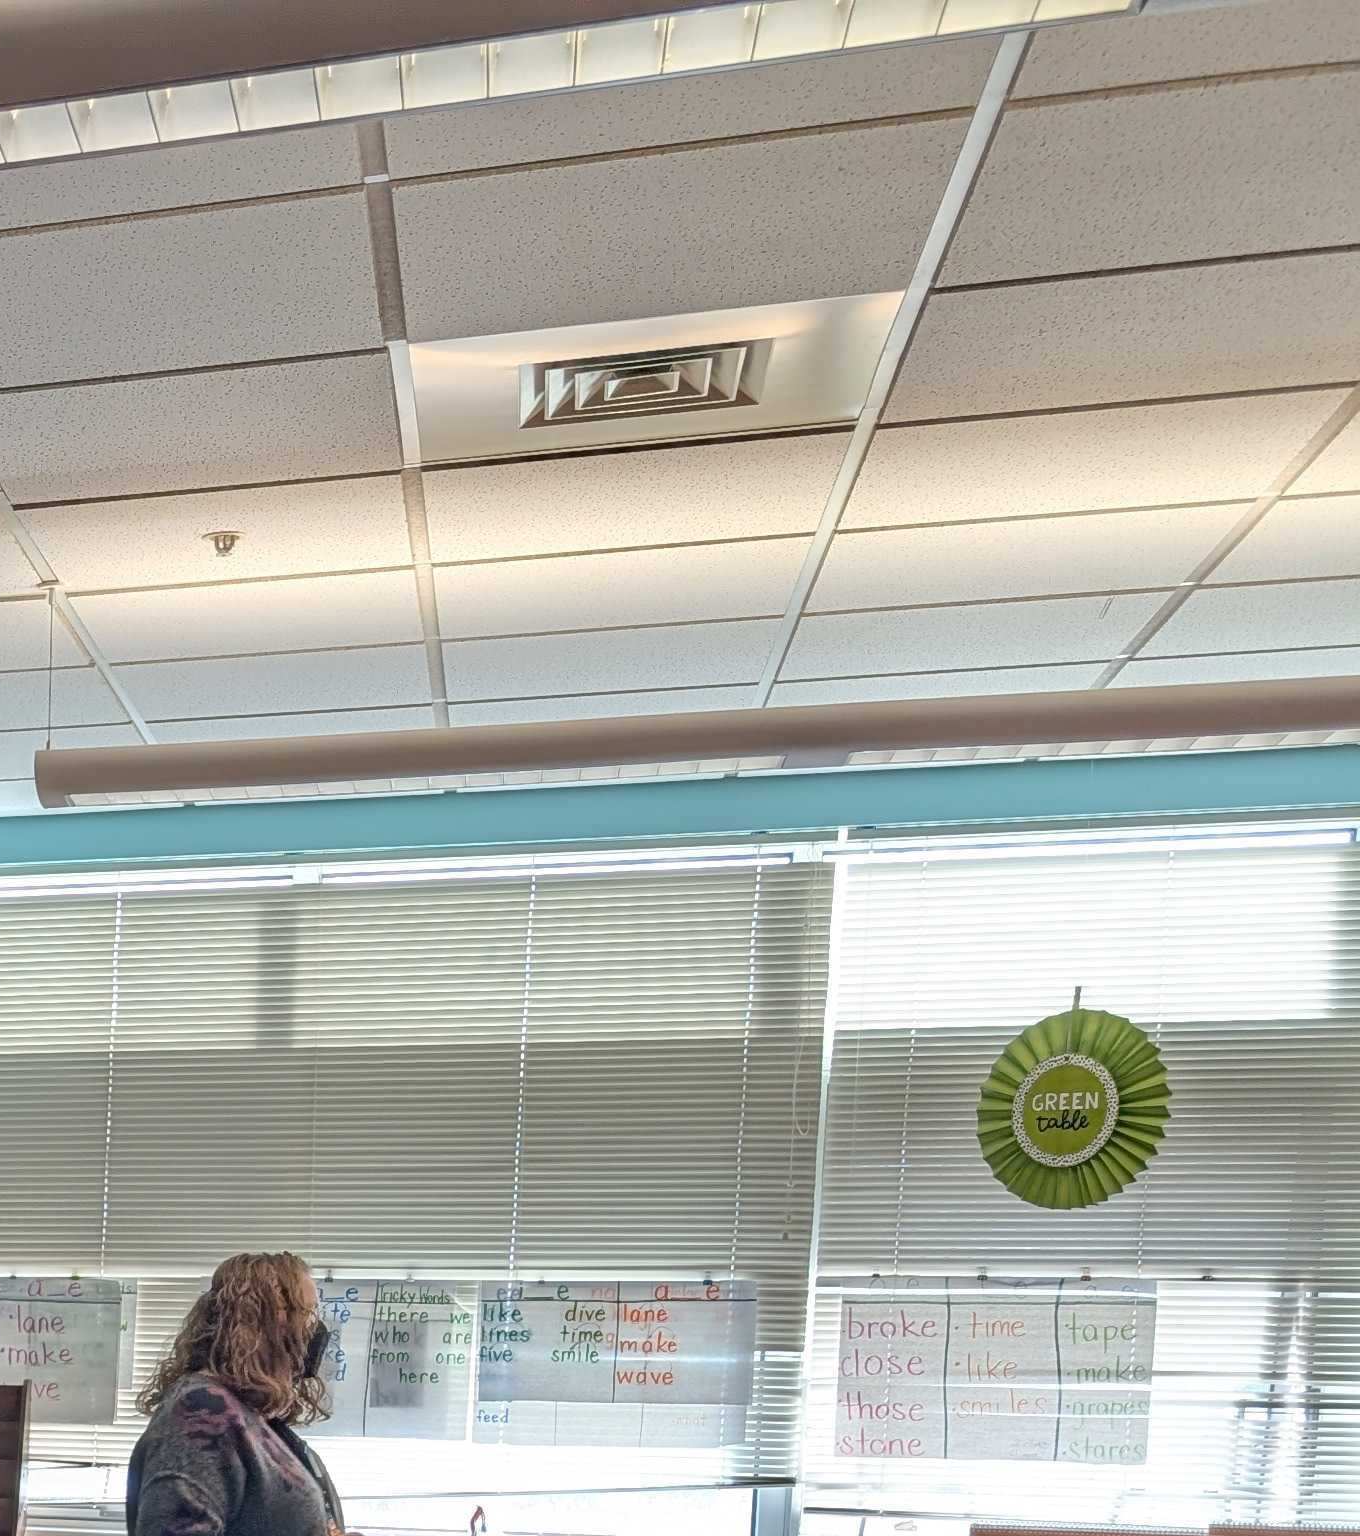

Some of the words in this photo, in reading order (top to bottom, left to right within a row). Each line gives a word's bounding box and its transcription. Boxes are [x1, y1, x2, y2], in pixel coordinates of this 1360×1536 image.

[1031, 1091, 1099, 1113] GREEN
[1035, 1109, 1090, 1133] table
[379, 1281, 416, 1308] Tricky
[16, 1305, 66, 1335] lane
[376, 1305, 430, 1324] there
[448, 1312, 471, 1325] we
[482, 1303, 523, 1323] like
[564, 1301, 607, 1323] dive
[622, 1304, 669, 1324] lane
[847, 1306, 938, 1340] broke
[374, 1325, 410, 1344] who
[442, 1332, 472, 1345] are
[481, 1325, 531, 1343] lines
[560, 1324, 604, 1344] time
[969, 1311, 1027, 1340] time
[1068, 1311, 1138, 1354] tape
[7, 1341, 73, 1366] make
[479, 1347, 514, 1363] five
[550, 1344, 600, 1364] smile
[619, 1333, 678, 1354] make
[371, 1348, 410, 1364] from
[435, 1352, 466, 1365] one
[840, 1348, 926, 1378] close
[967, 1351, 1018, 1382] like
[399, 1367, 440, 1384] here
[616, 1367, 674, 1386] wave
[1076, 1355, 1147, 1383] make
[477, 1408, 509, 1425] feed
[844, 1391, 926, 1423] those
[841, 1426, 926, 1457] stone
